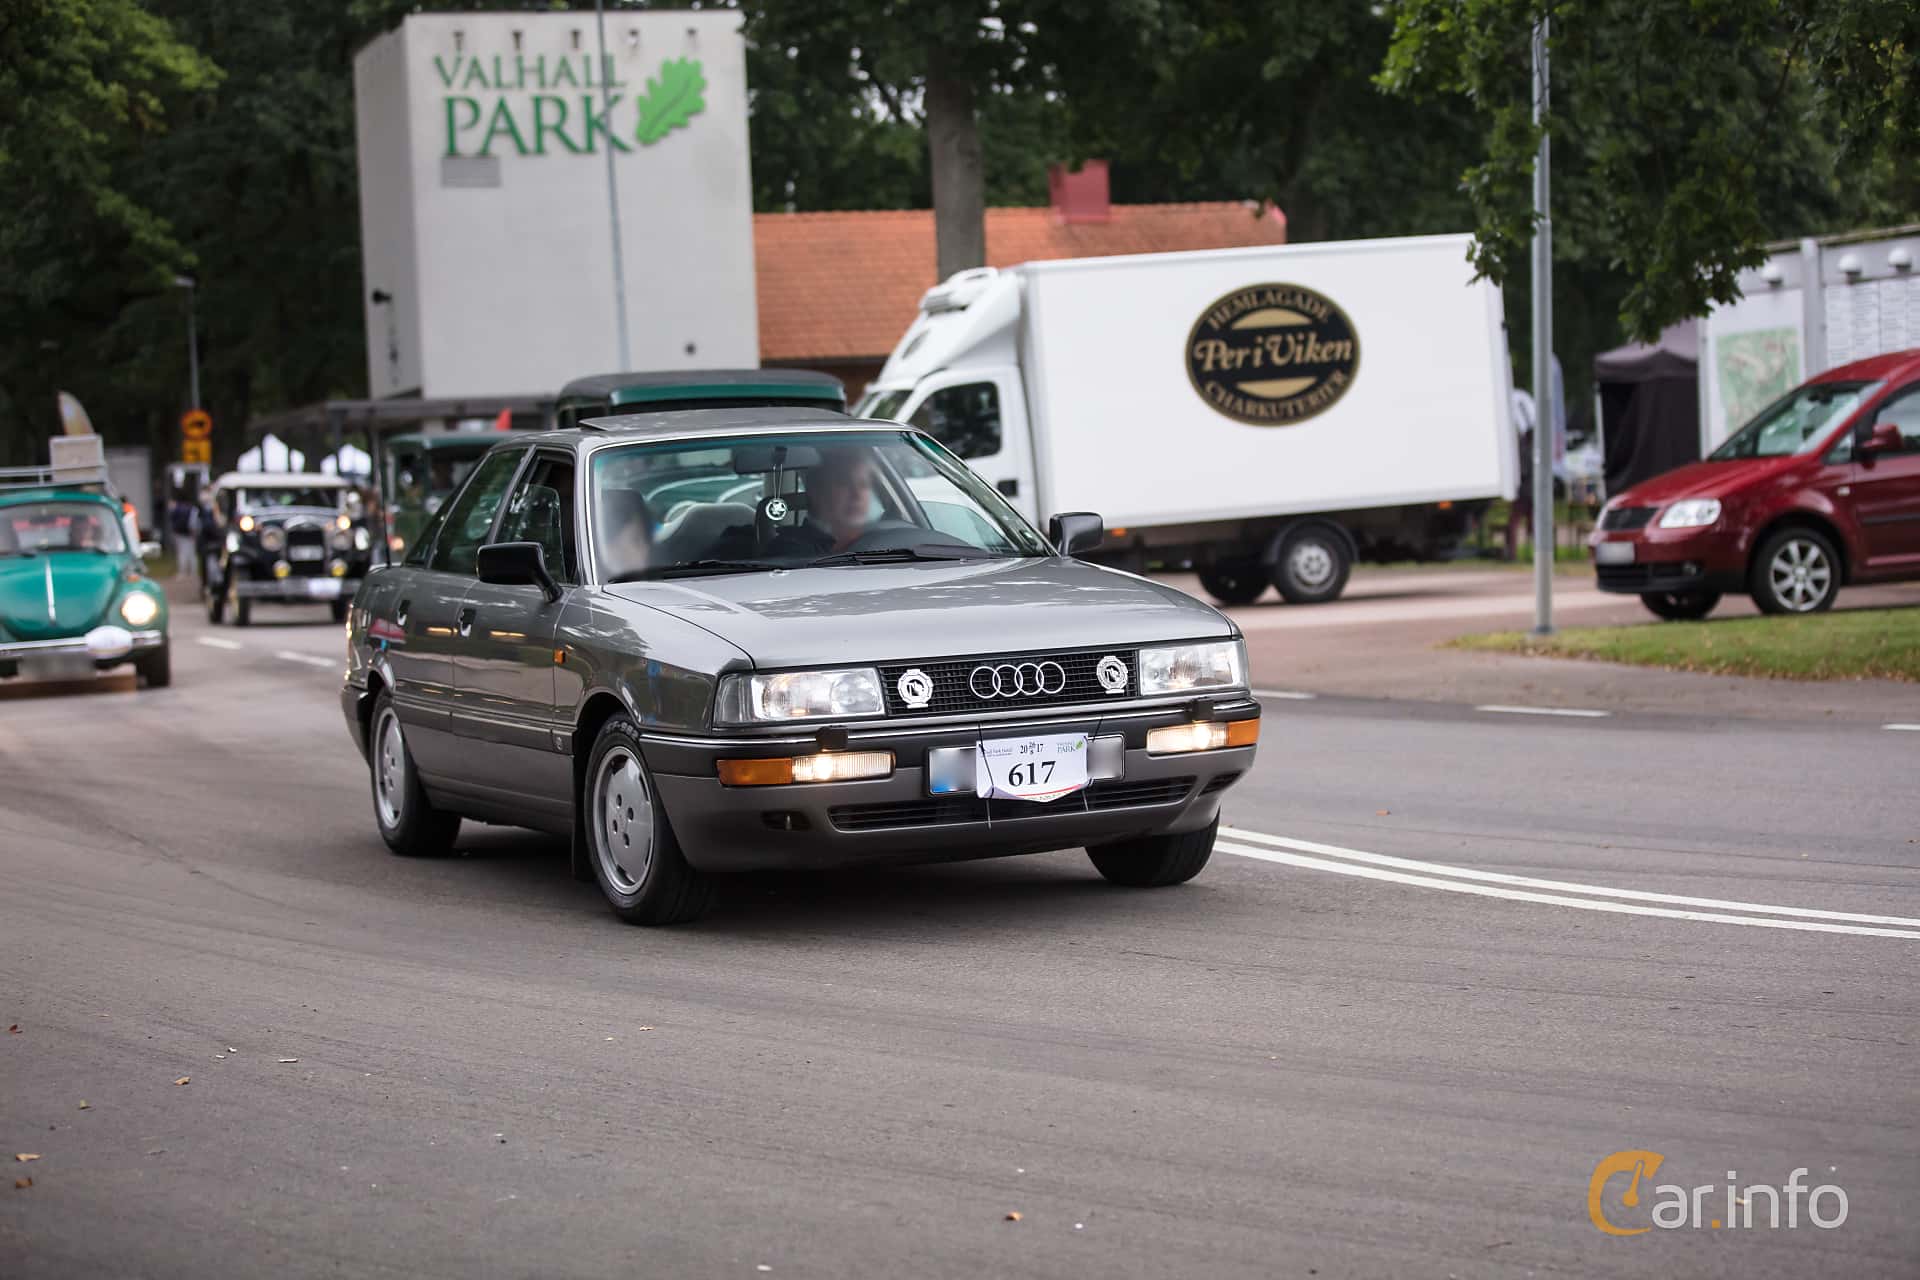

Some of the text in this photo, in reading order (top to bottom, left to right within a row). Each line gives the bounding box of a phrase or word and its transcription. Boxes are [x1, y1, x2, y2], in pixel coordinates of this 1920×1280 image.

[433, 53, 627, 89] VALHALL
[442, 94, 634, 157] PARK
[1193, 338, 1250, 371] Per
[1265, 332, 1353, 367] Viken
[1008, 760, 1056, 787] 617
